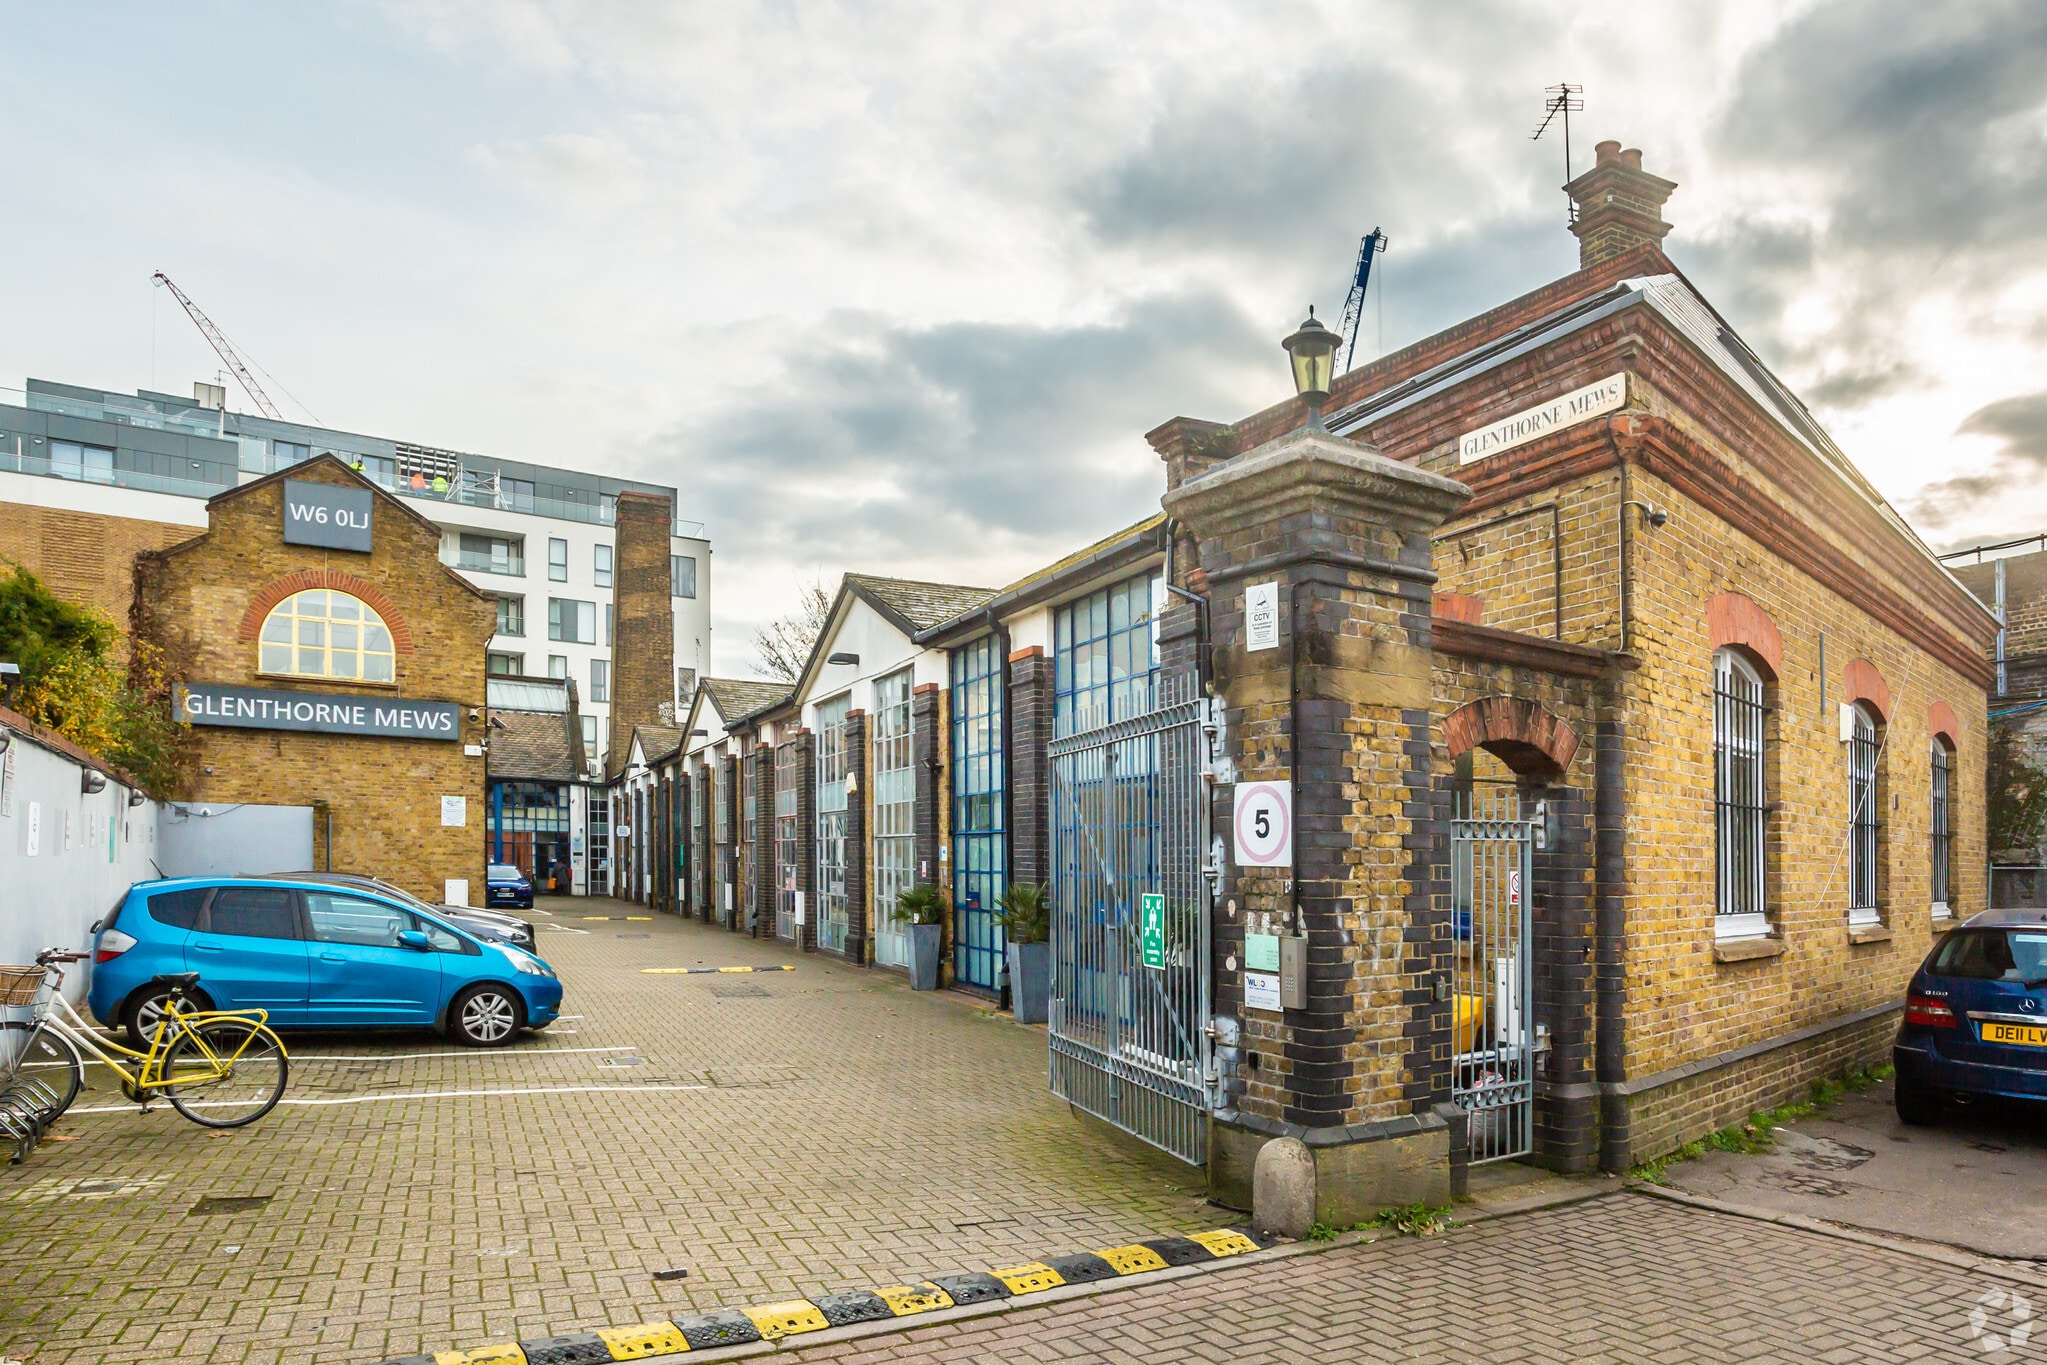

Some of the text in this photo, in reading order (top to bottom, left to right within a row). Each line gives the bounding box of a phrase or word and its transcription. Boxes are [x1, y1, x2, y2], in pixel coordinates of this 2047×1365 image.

[1464, 383, 1618, 457] GLENTHORNE MEWS
[289, 502, 328, 524] W6
[1253, 612, 1271, 621] CCTV
[185, 694, 453, 731] GLENTHORNE MEWS
[1255, 809, 1270, 839] 5
[1995, 1026, 2024, 1041] DE11
